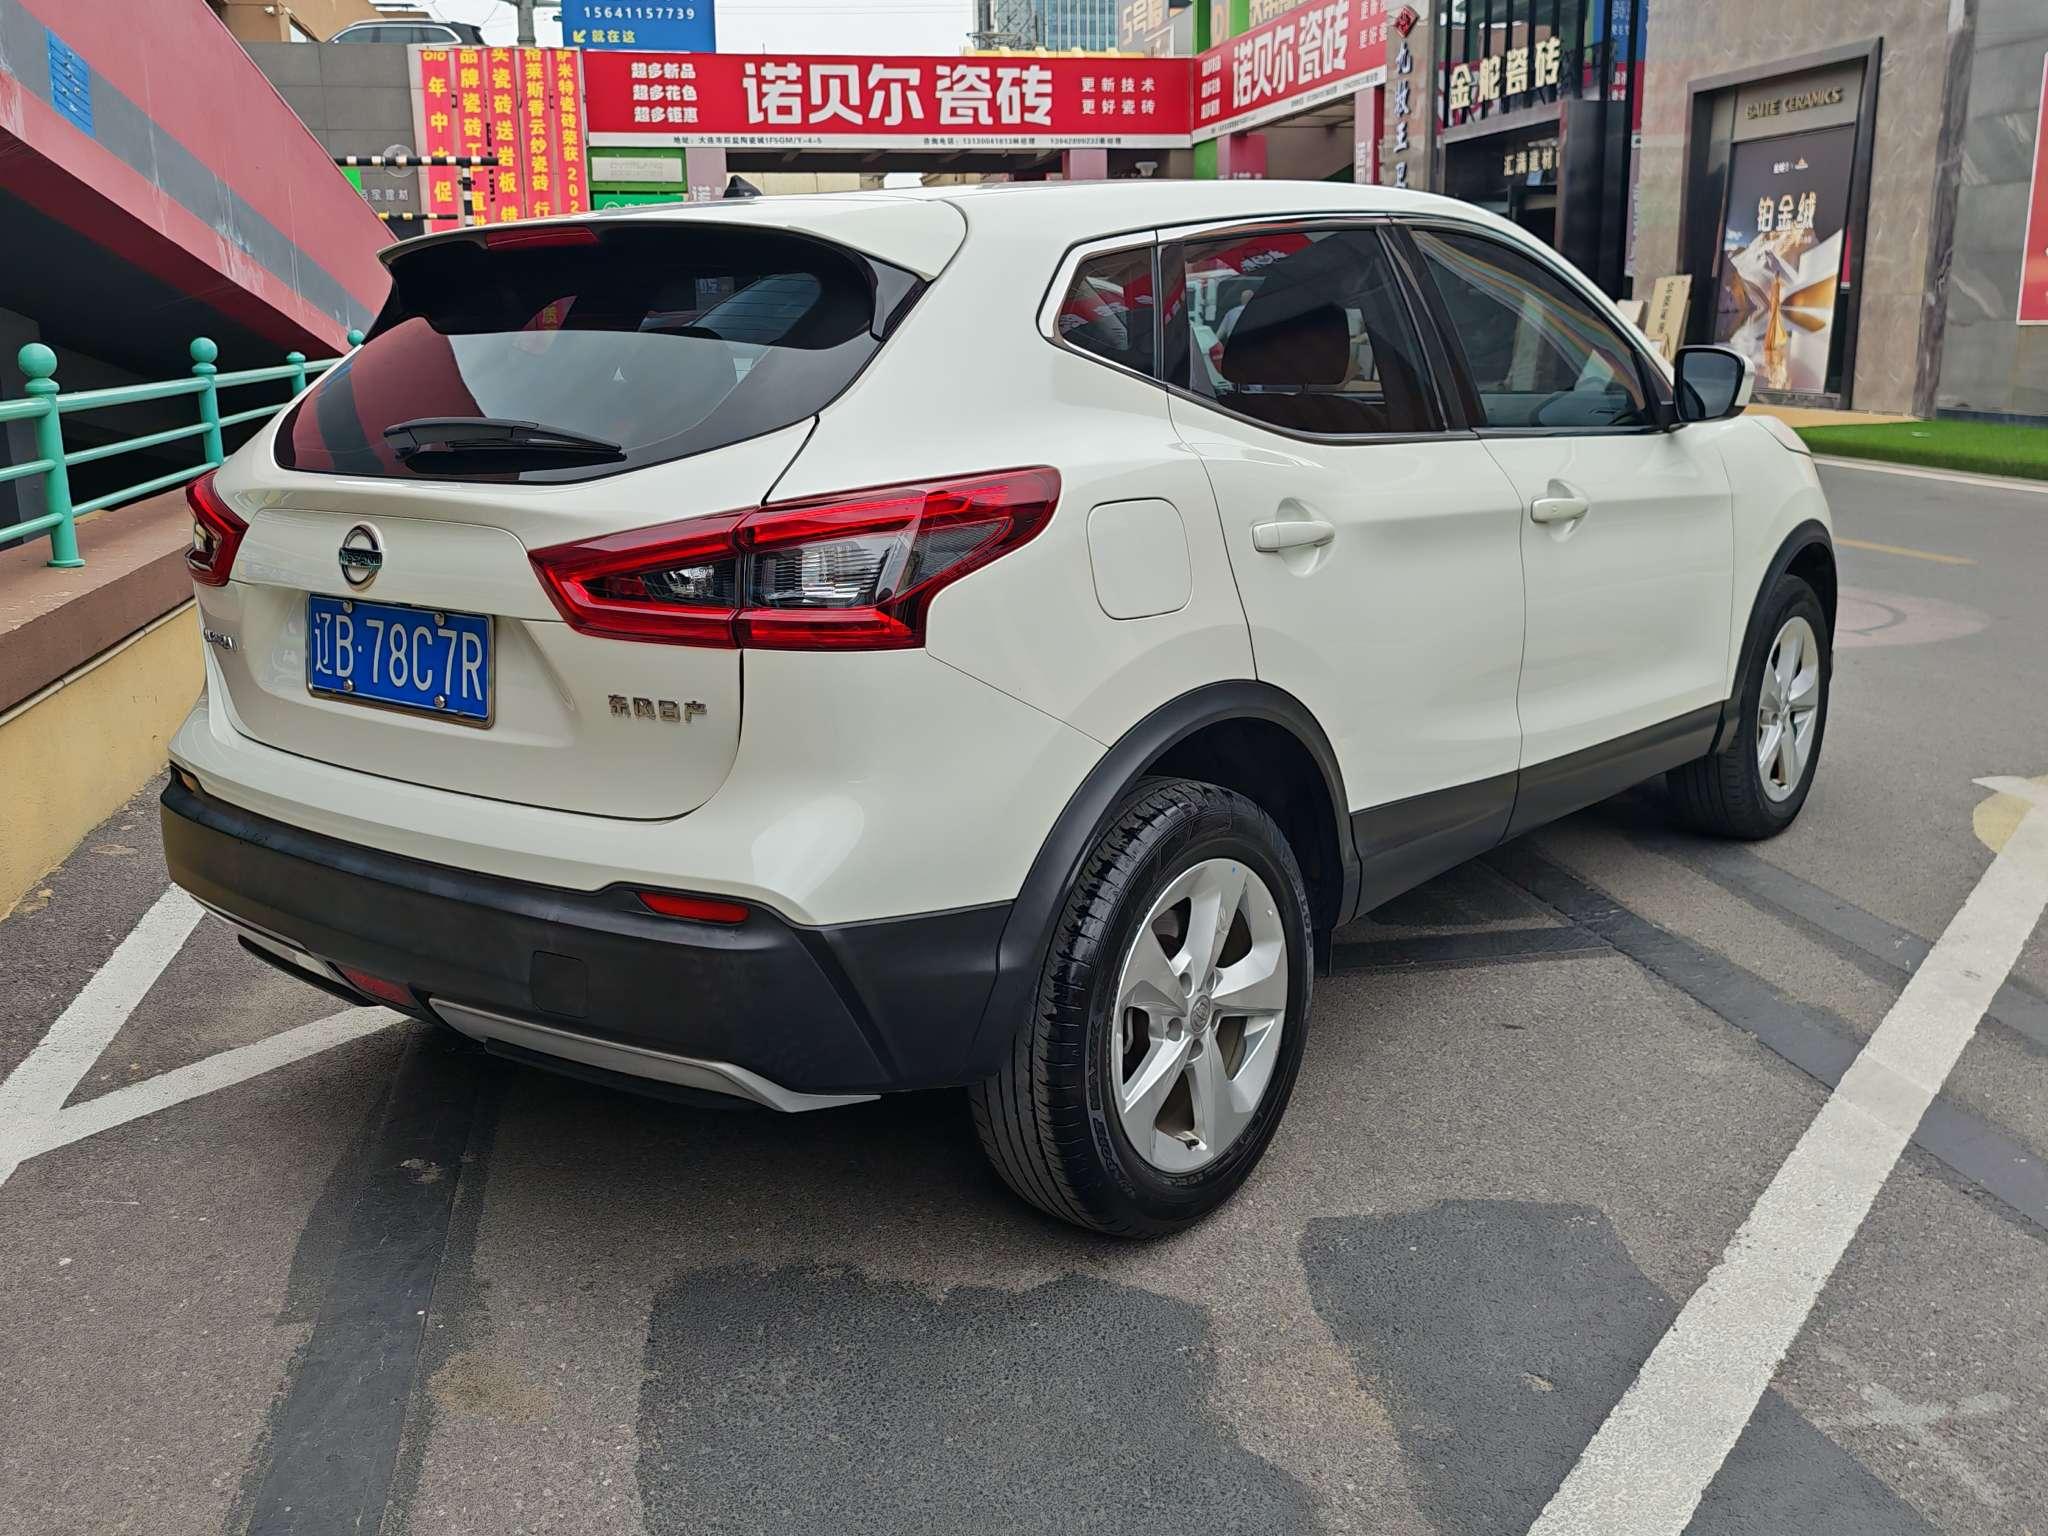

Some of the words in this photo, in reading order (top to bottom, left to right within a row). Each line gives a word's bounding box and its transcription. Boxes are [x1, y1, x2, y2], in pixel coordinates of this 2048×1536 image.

[584, 7, 695, 20] 15641157739
[592, 30, 636, 43] 就在这
[1232, 0, 1349, 109] 诺贝尔瓷砖
[631, 63, 696, 79] 超多新品
[632, 84, 698, 101] 超多花色
[1081, 77, 1156, 93] 更新技术
[742, 62, 1053, 126] 诺贝尔瓷砖
[1081, 98, 1156, 115] 更好瓷砖
[340, 548, 382, 568] NISSAN
[608, 694, 707, 723] 东风日产
